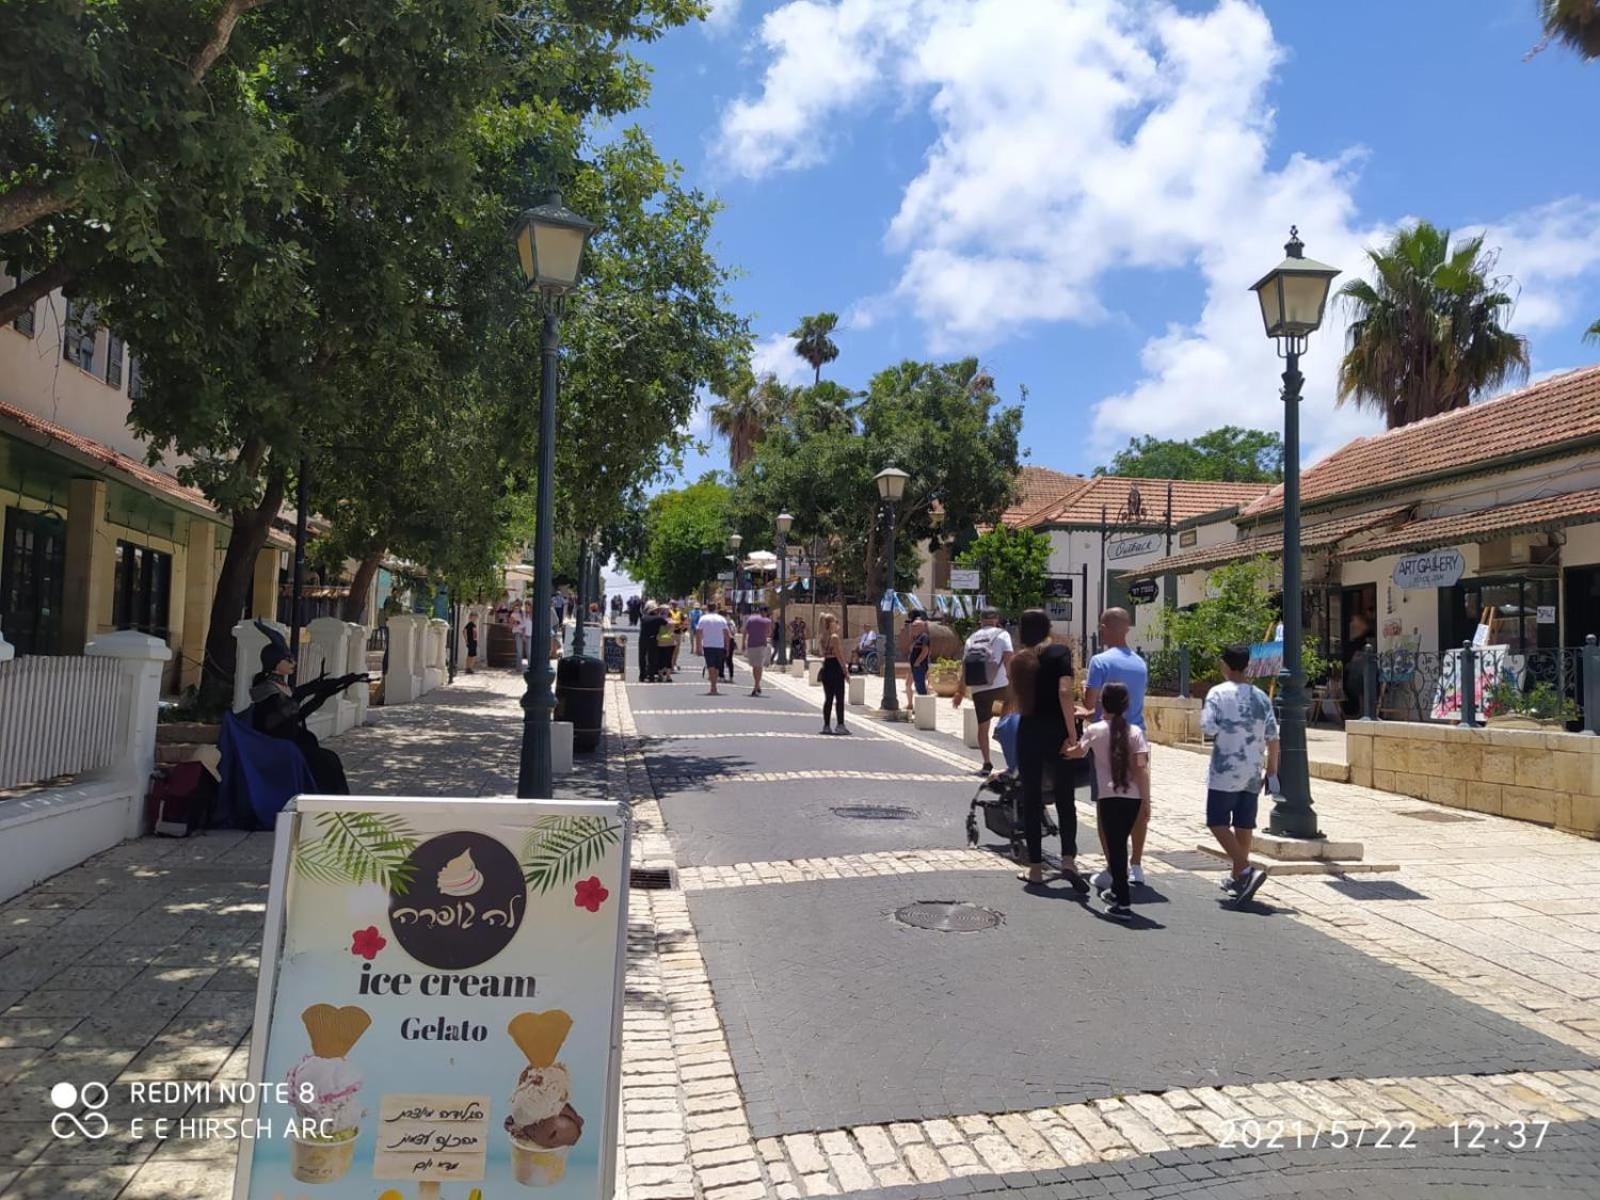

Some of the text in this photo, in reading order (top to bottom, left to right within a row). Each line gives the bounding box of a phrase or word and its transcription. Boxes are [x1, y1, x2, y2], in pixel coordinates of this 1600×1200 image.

[1399, 554, 1459, 575] ART GALLERY
[481, 894, 521, 928] לה
[359, 962, 537, 998] ice cream
[401, 1016, 488, 1042] Gelato
